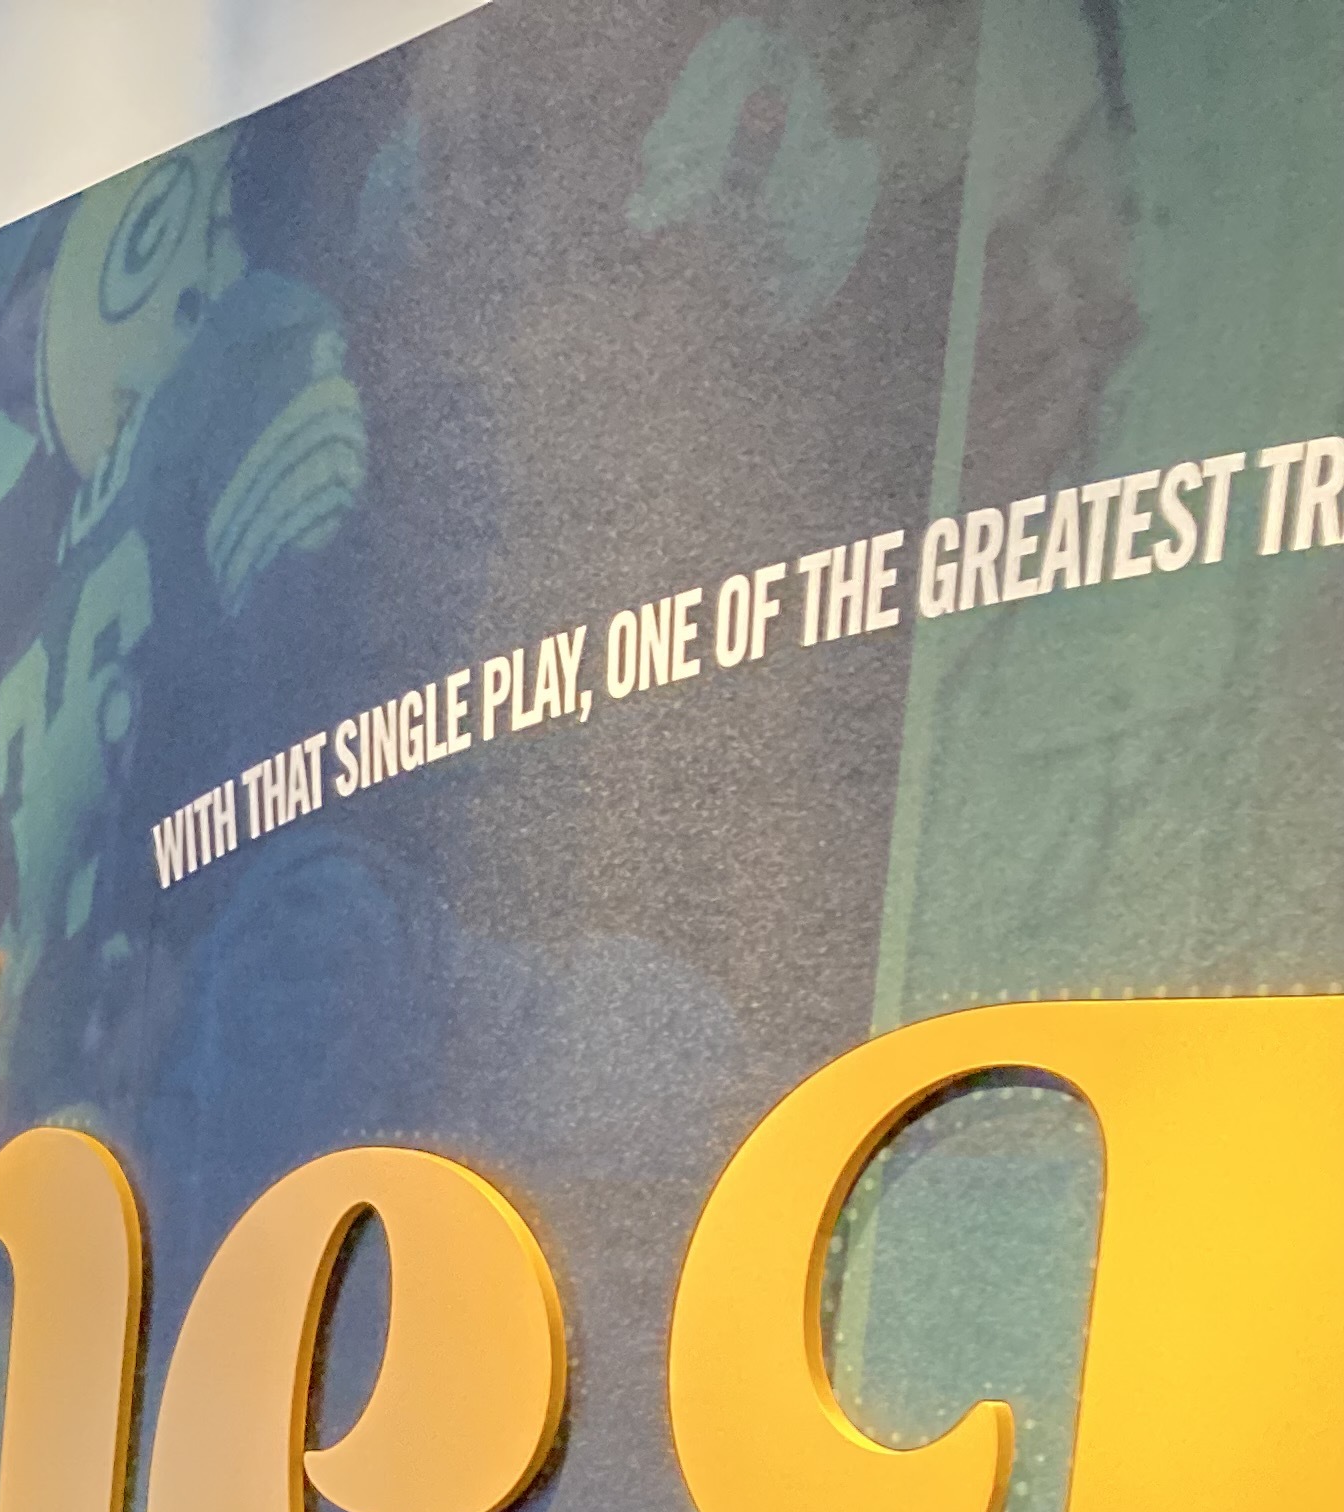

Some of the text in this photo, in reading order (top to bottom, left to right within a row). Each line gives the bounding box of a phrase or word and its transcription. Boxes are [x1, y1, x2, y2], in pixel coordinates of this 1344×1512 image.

[151, 779, 238, 889] WITH
[241, 731, 327, 839] THAT
[335, 668, 472, 797] SINGLE
[482, 625, 593, 742] PLAY,
[606, 587, 703, 699] ONE
[715, 562, 787, 668] OF
[798, 529, 905, 648] THE
[918, 452, 1246, 618] GREATEST
